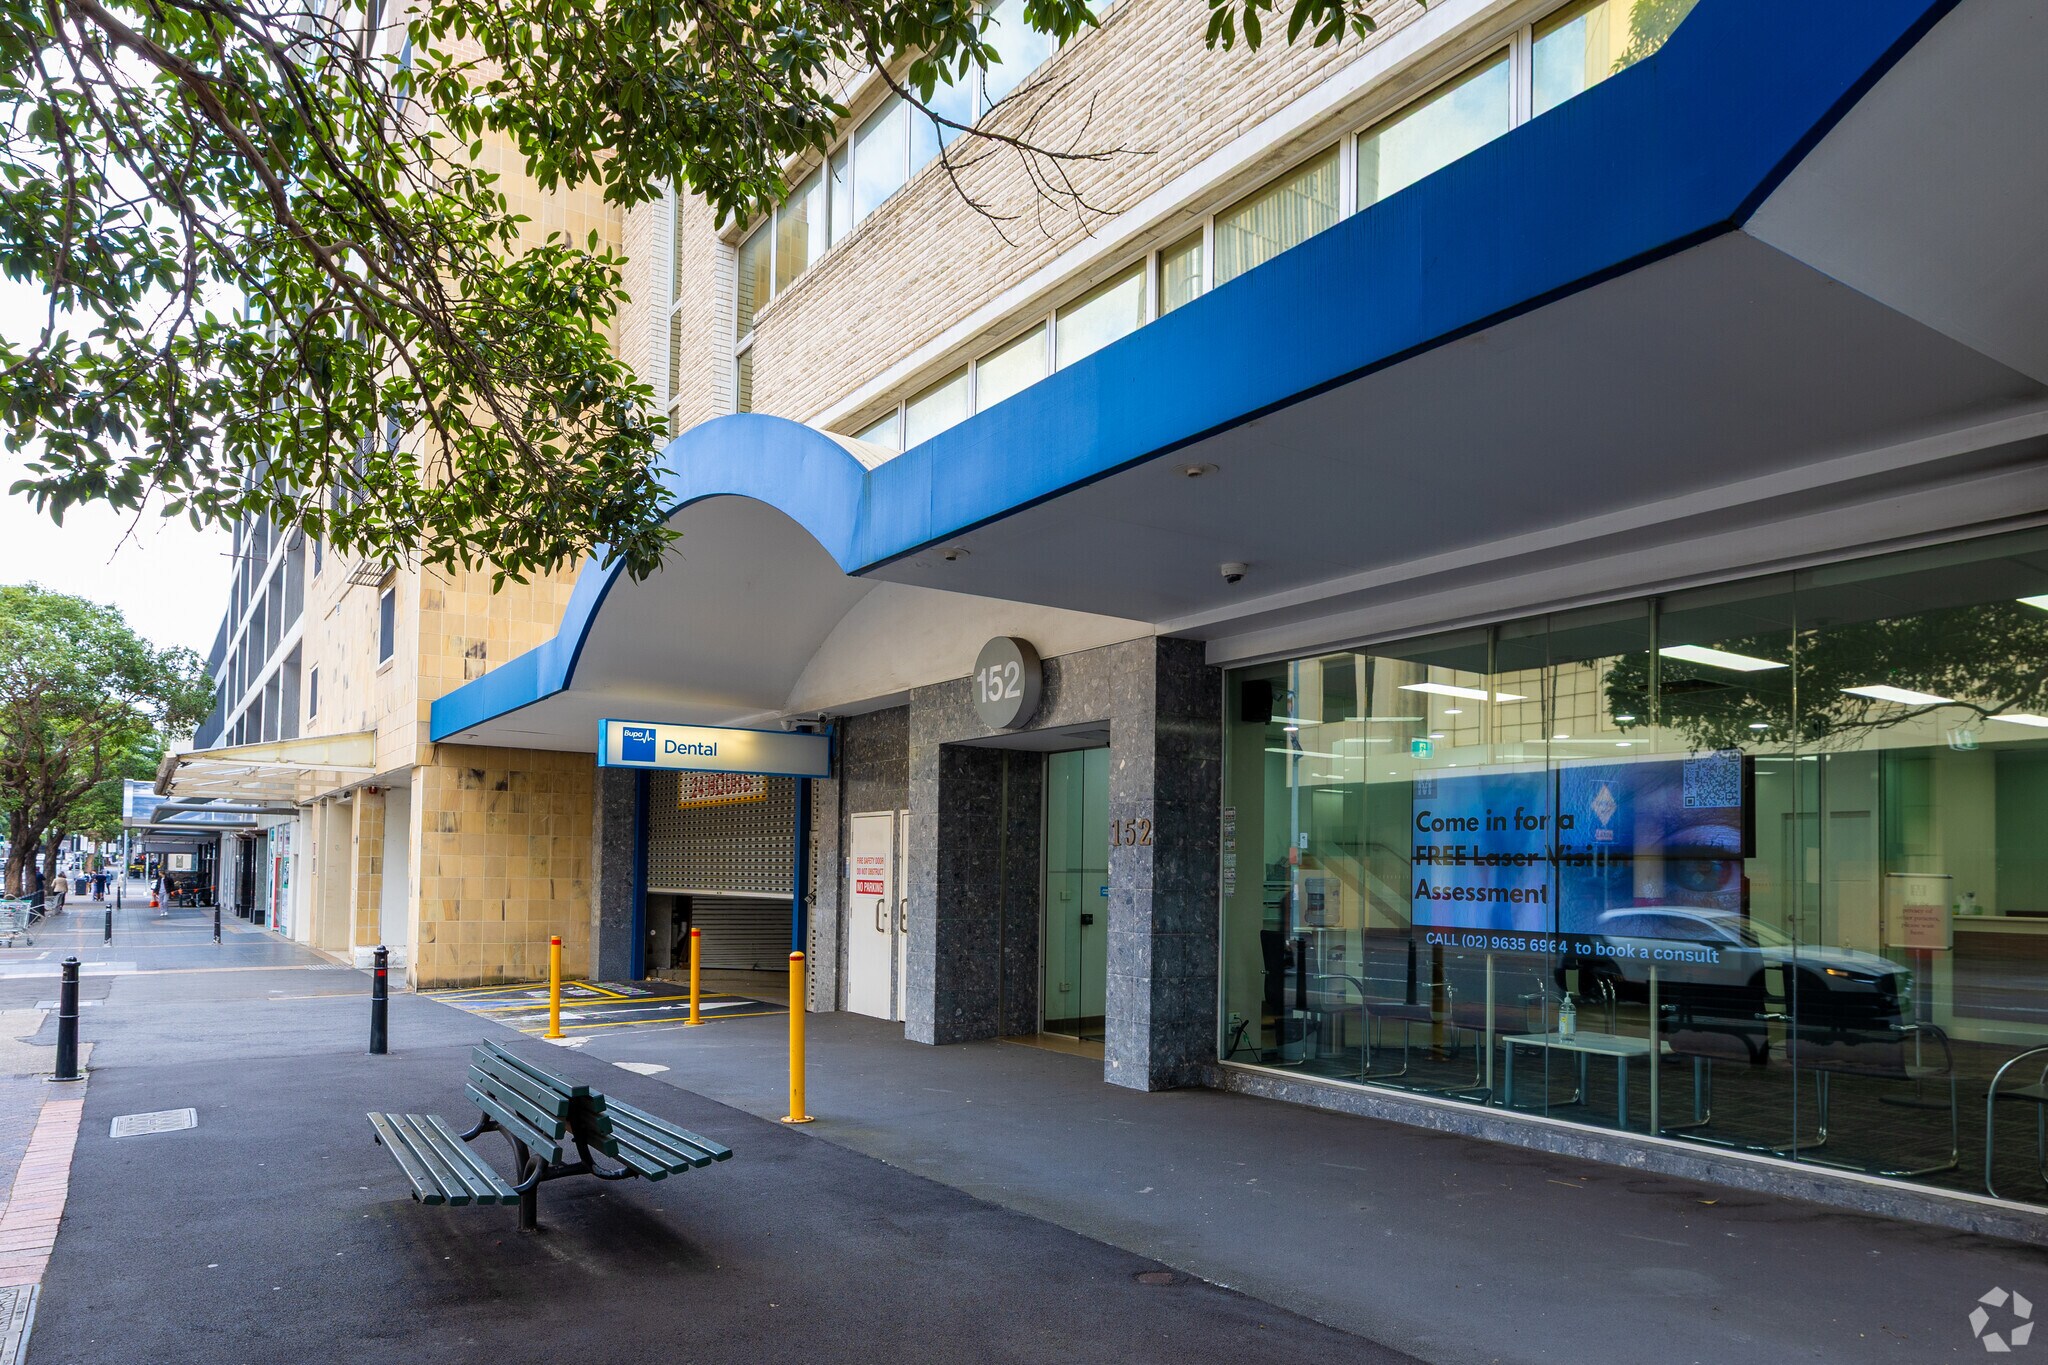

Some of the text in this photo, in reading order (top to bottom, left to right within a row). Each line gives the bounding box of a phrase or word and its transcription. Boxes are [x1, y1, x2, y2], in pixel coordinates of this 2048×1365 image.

[976, 661, 1021, 703] 152
[624, 730, 643, 738] Bupa
[664, 739, 718, 756] Dental
[707, 773, 751, 796] HOURS
[1415, 806, 1574, 832] Come in for a
[1112, 818, 1152, 847] 152
[875, 857, 884, 865] DOOR
[1416, 845, 1466, 866] FREE
[1474, 845, 1539, 867] Laser
[857, 882, 883, 893] NO PARKING
[1414, 878, 1548, 904] Assessment
[1426, 932, 1720, 964] CALL (02) 9635 6964 to book a consult
